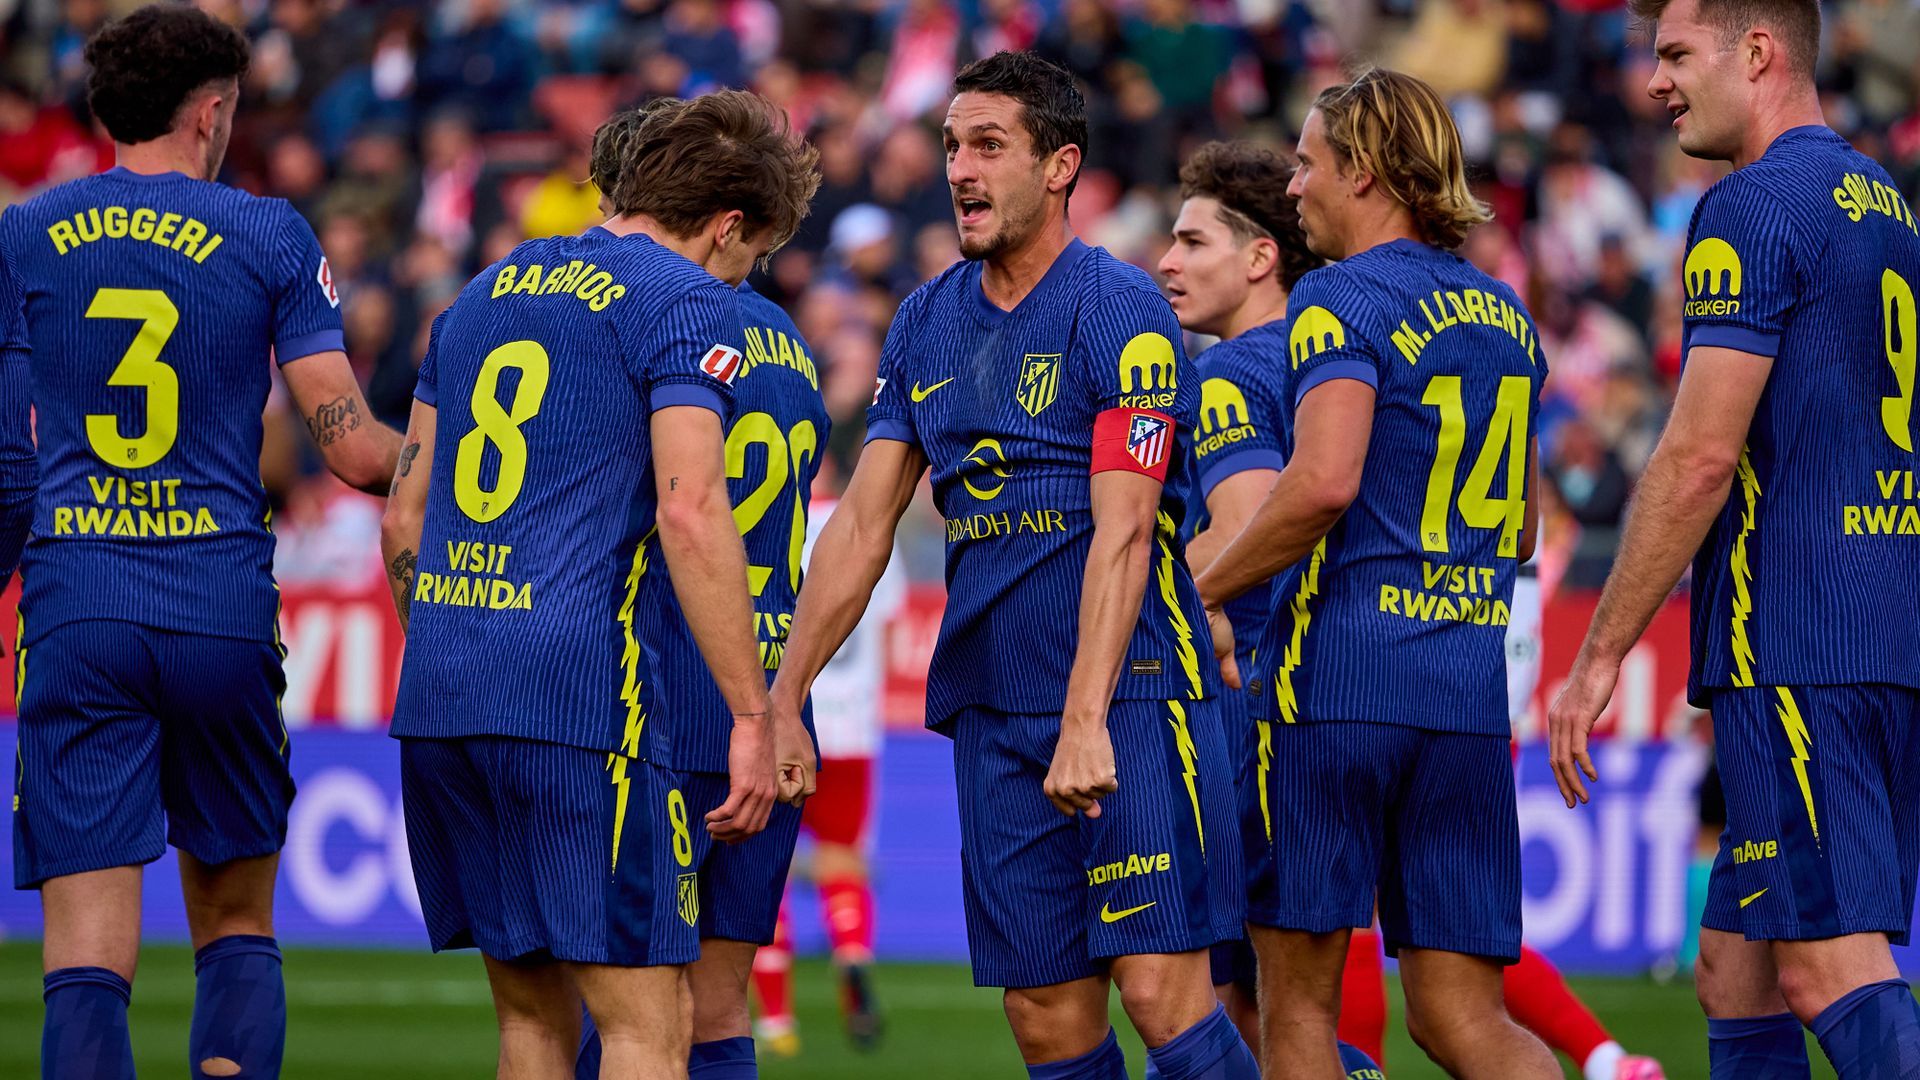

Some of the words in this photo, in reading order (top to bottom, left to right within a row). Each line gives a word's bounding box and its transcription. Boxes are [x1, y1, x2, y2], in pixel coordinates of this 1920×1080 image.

[47, 206, 223, 264] RUGGERI
[491, 260, 626, 312] BARRIOS
[1684, 299, 1740, 317] kraken
[85, 287, 180, 469] 3
[1881, 268, 1918, 453] 9
[453, 339, 550, 524] 8
[1194, 424, 1257, 460] kraken
[1421, 375, 1531, 558] 14
[1875, 470, 1920, 500] VI
[88, 476, 182, 507] VISIT
[54, 506, 220, 537] RWANDA
[945, 514, 1012, 543] RIYADH
[1018, 509, 1067, 534] AIR
[447, 541, 512, 575] VISIT
[413, 572, 533, 610] RWANDA
[1422, 561, 1496, 595] VISIT
[1379, 584, 1511, 626] RWANDA
[667, 788, 693, 868] 8
[1087, 853, 1170, 887] omAve
